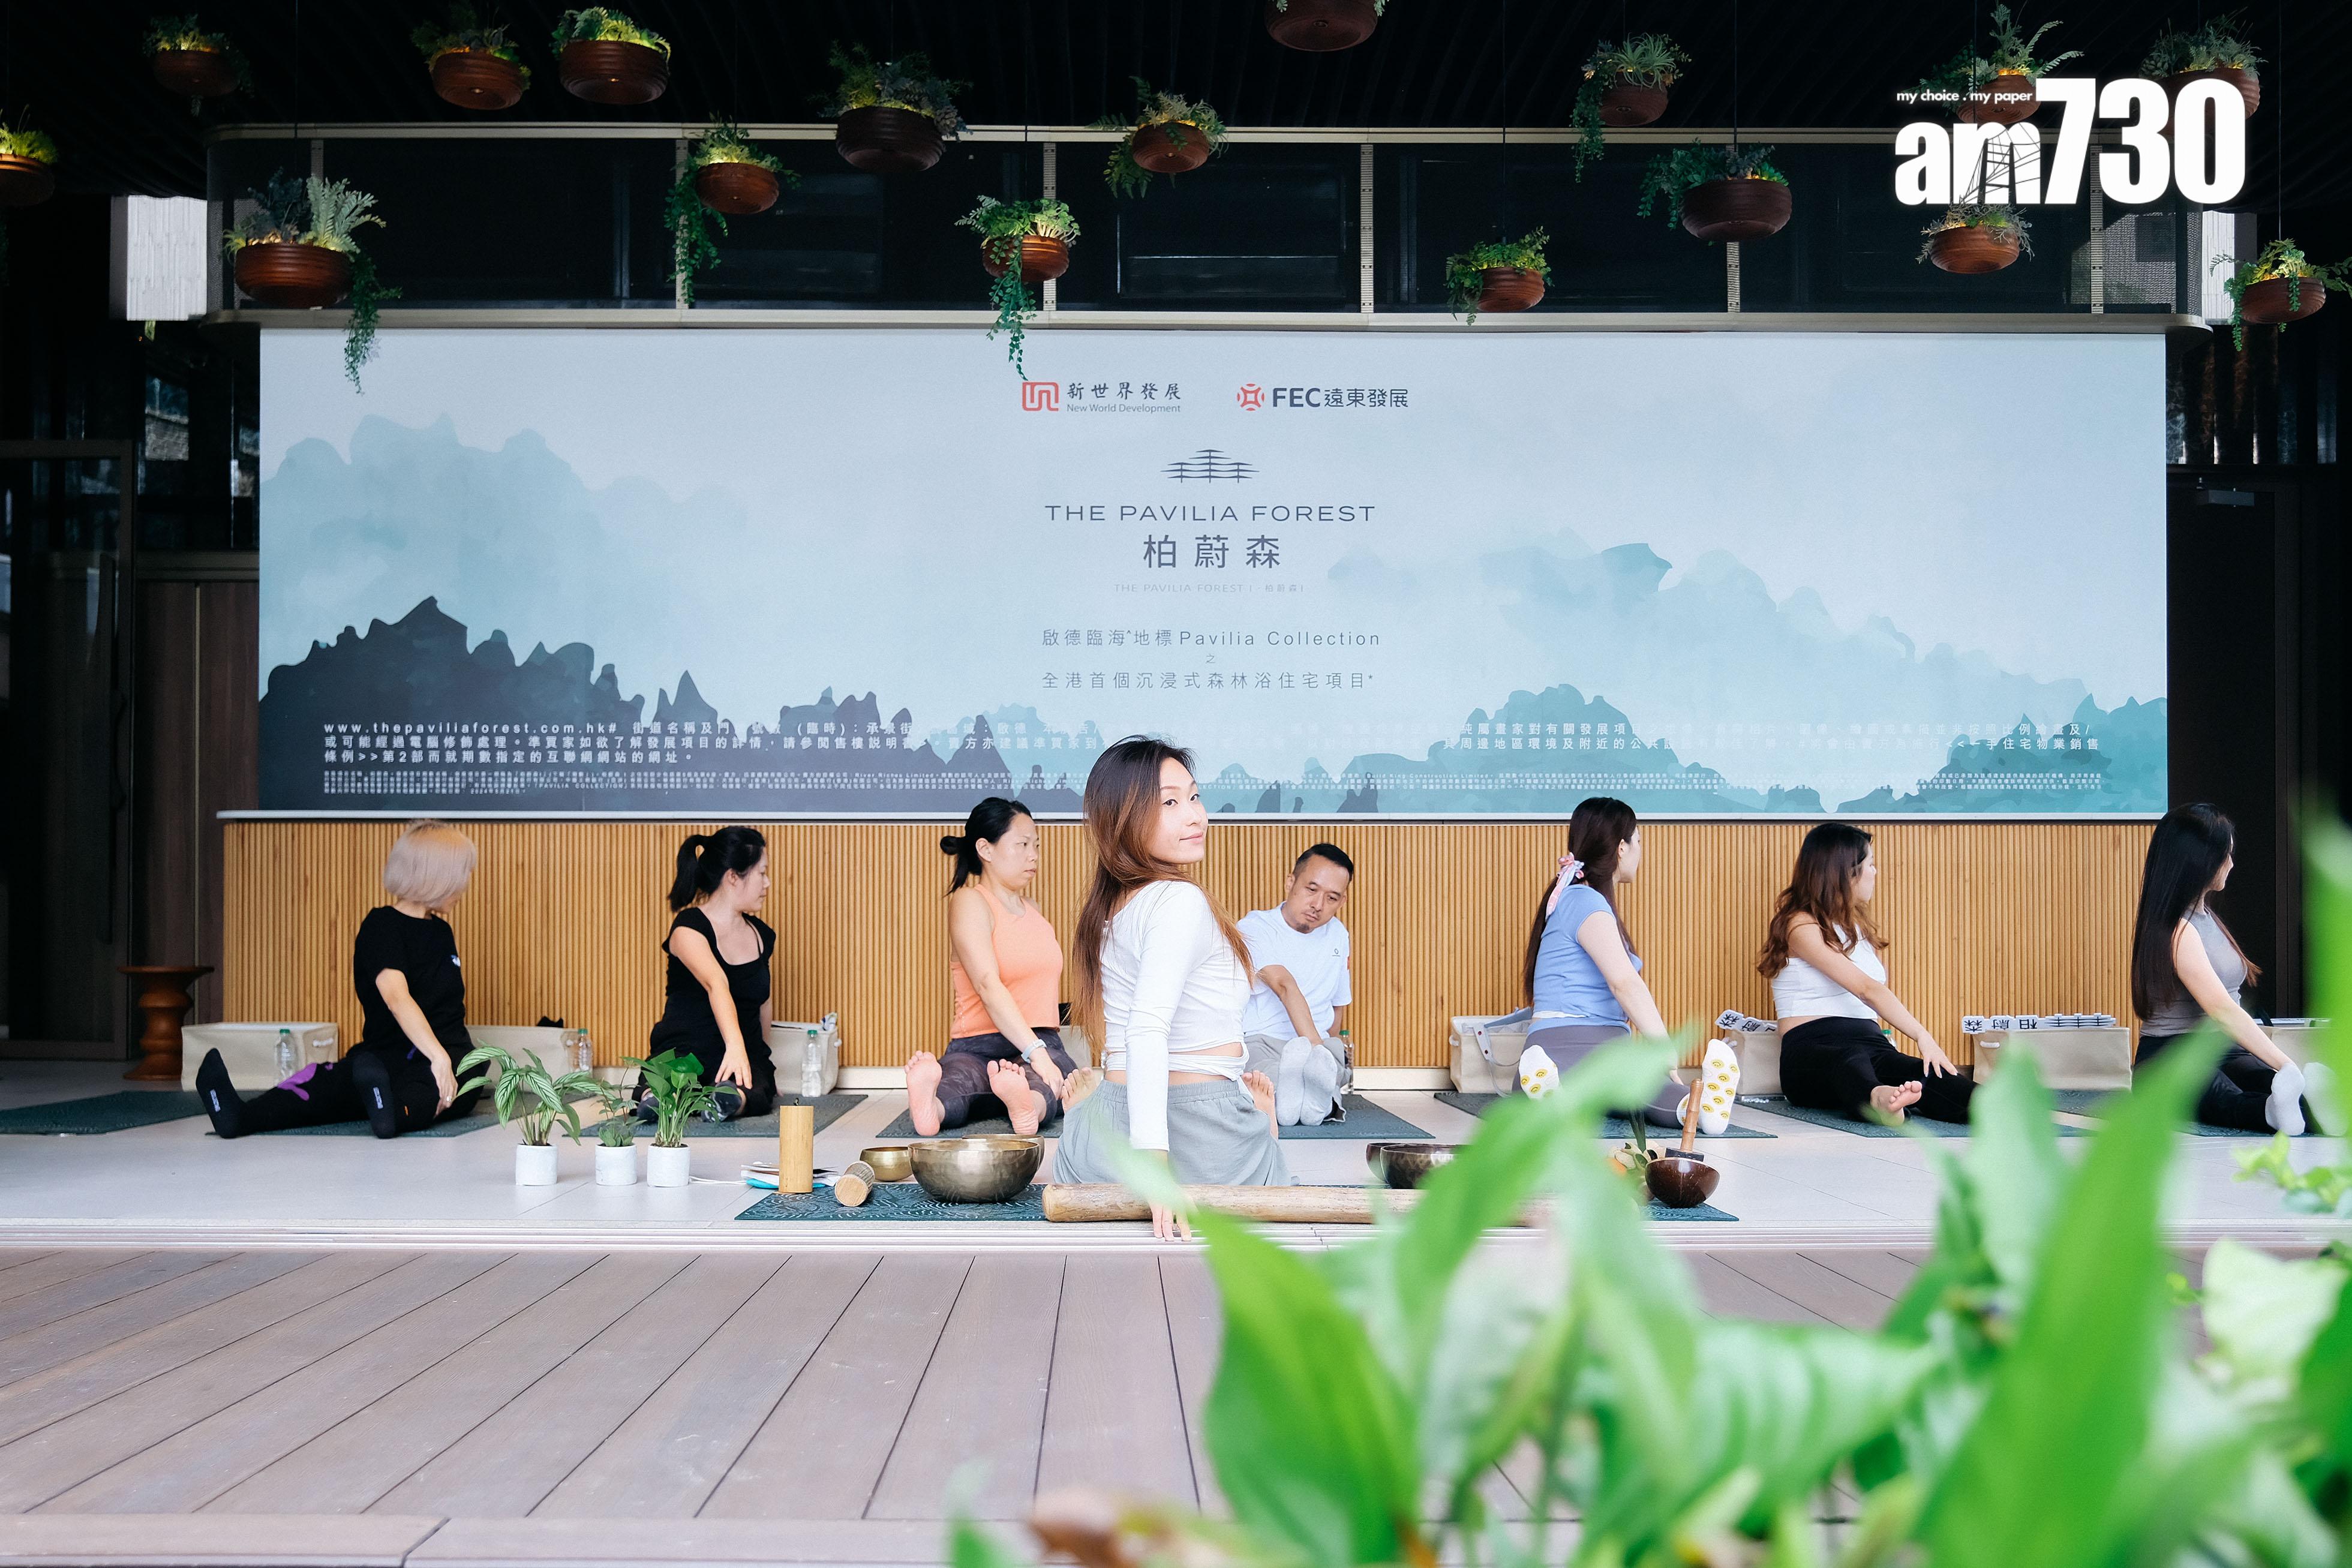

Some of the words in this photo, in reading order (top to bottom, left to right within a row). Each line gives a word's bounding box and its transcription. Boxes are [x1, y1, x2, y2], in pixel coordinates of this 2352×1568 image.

[1067, 382, 1181, 401] 新世界發展
[1272, 388, 1321, 408] FEC
[1324, 388, 1408, 408] 遠東發展
[1067, 404, 1088, 412] New
[1089, 404, 1116, 412] World
[1119, 404, 1181, 414] Development
[1044, 505, 1106, 521] THE
[1120, 505, 1238, 521] PAVILIA
[1252, 505, 1375, 522] FOREST
[1143, 534, 1281, 569] 柏蔚森
[1114, 584, 1137, 593] THE
[1143, 584, 1192, 593] PAVILIA
[1197, 584, 1243, 593] FOREST
[1180, 631, 1254, 645] Pavilia
[1267, 631, 1379, 645] Collection
[1205, 653, 1216, 664] 之
